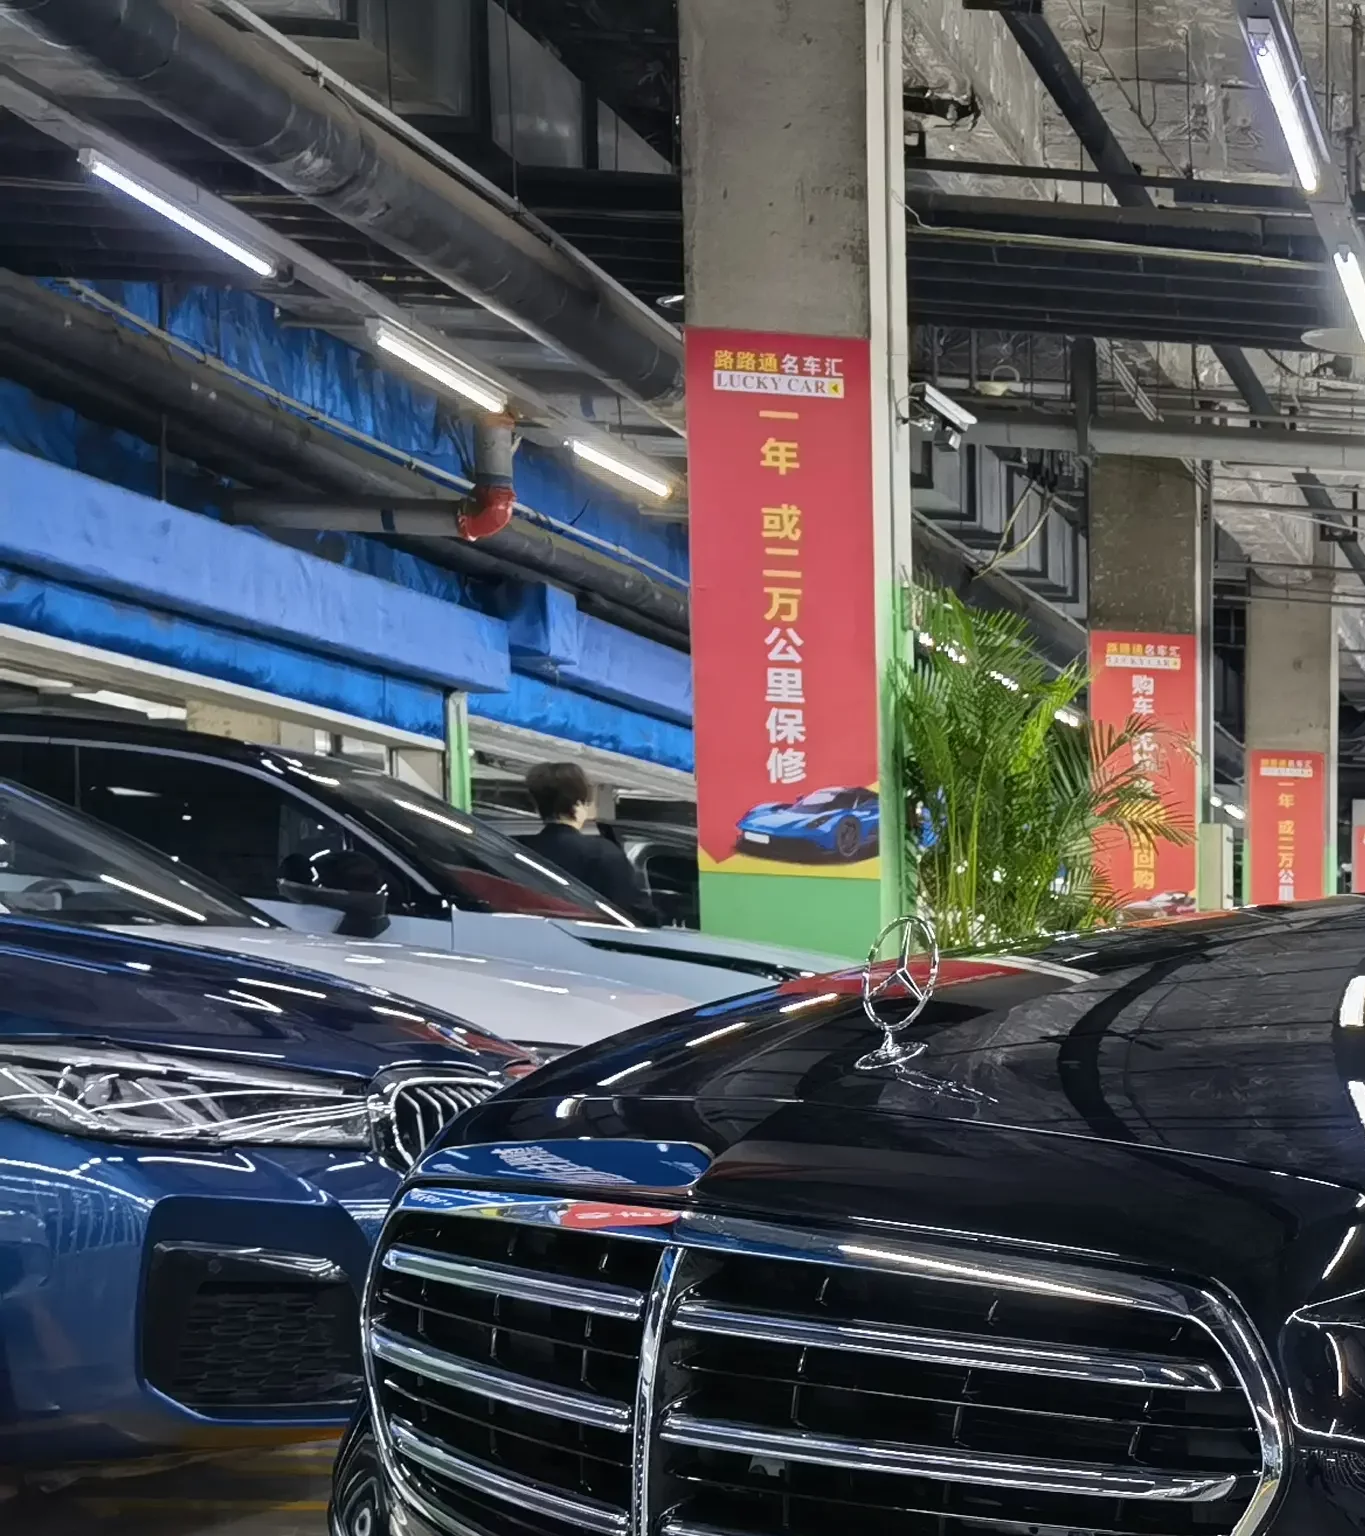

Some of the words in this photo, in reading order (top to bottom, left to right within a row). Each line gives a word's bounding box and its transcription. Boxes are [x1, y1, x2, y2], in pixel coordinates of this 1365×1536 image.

[714, 350, 844, 377] 路路通名车汇
[716, 373, 782, 391] LUCKY
[787, 378, 826, 394] CAR
[759, 410, 800, 475] 一年
[761, 503, 807, 785] 或二万公里保修
